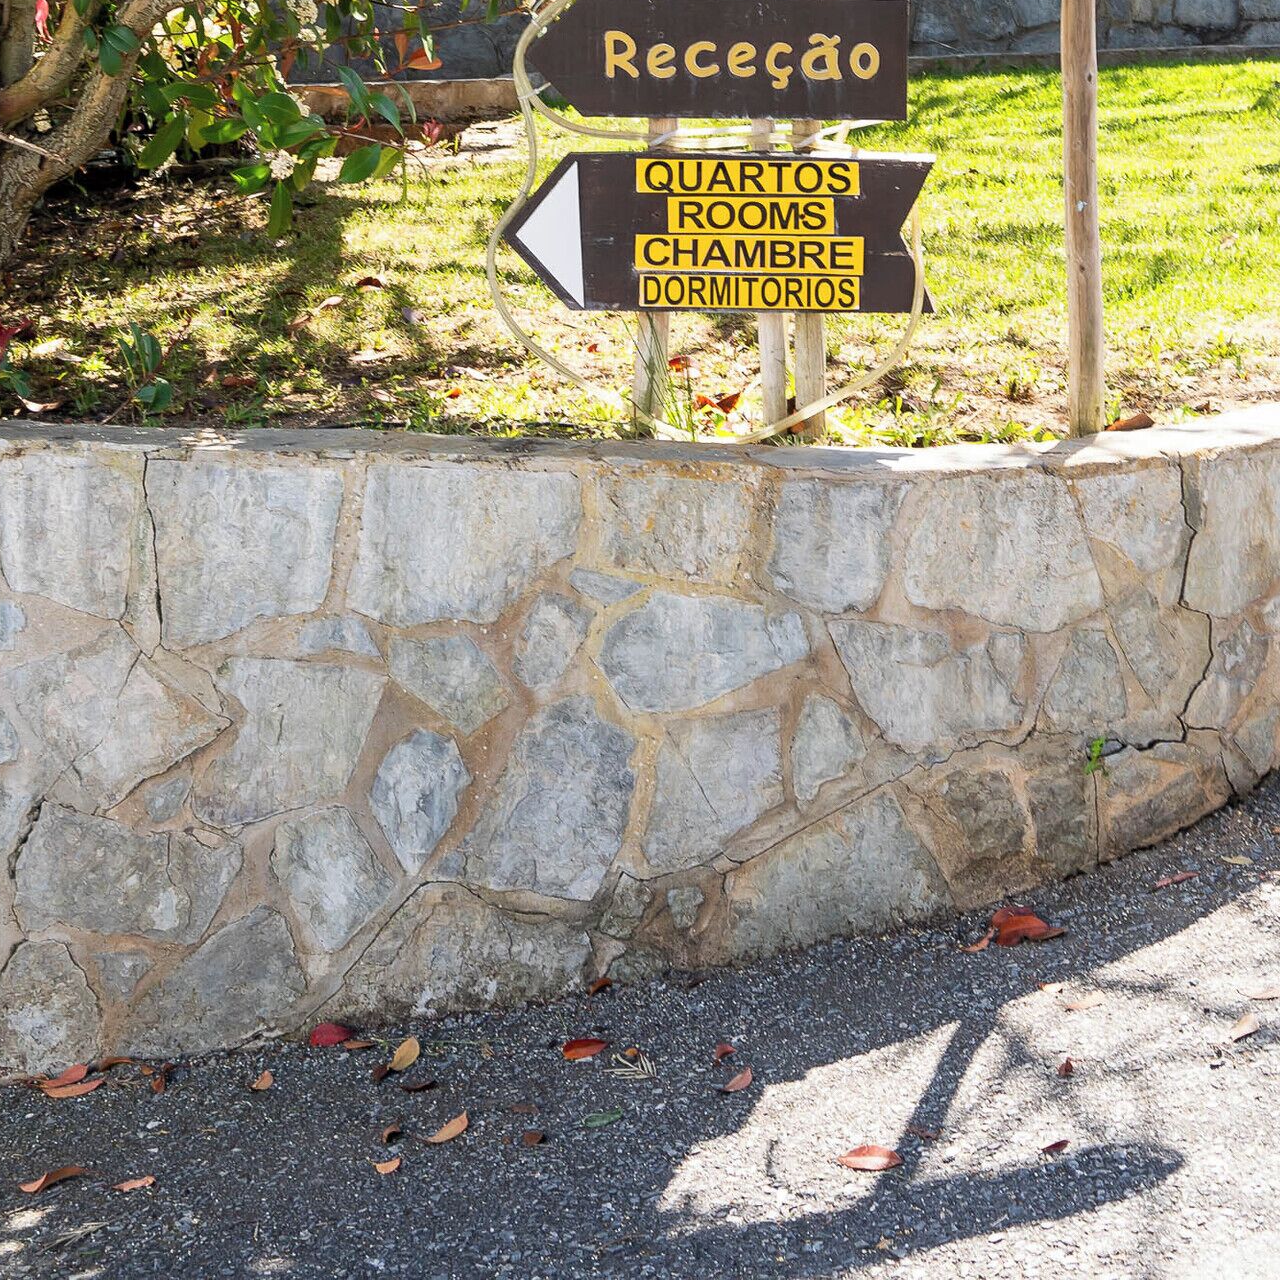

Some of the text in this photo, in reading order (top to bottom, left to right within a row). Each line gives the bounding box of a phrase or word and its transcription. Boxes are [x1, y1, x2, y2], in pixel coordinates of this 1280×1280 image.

[604, 30, 880, 89] Receção
[644, 160, 852, 195] QUARTOS
[677, 200, 827, 231] ROOMS
[642, 237, 855, 270] CHAMBRE
[643, 276, 856, 309] DORMITORIOS
